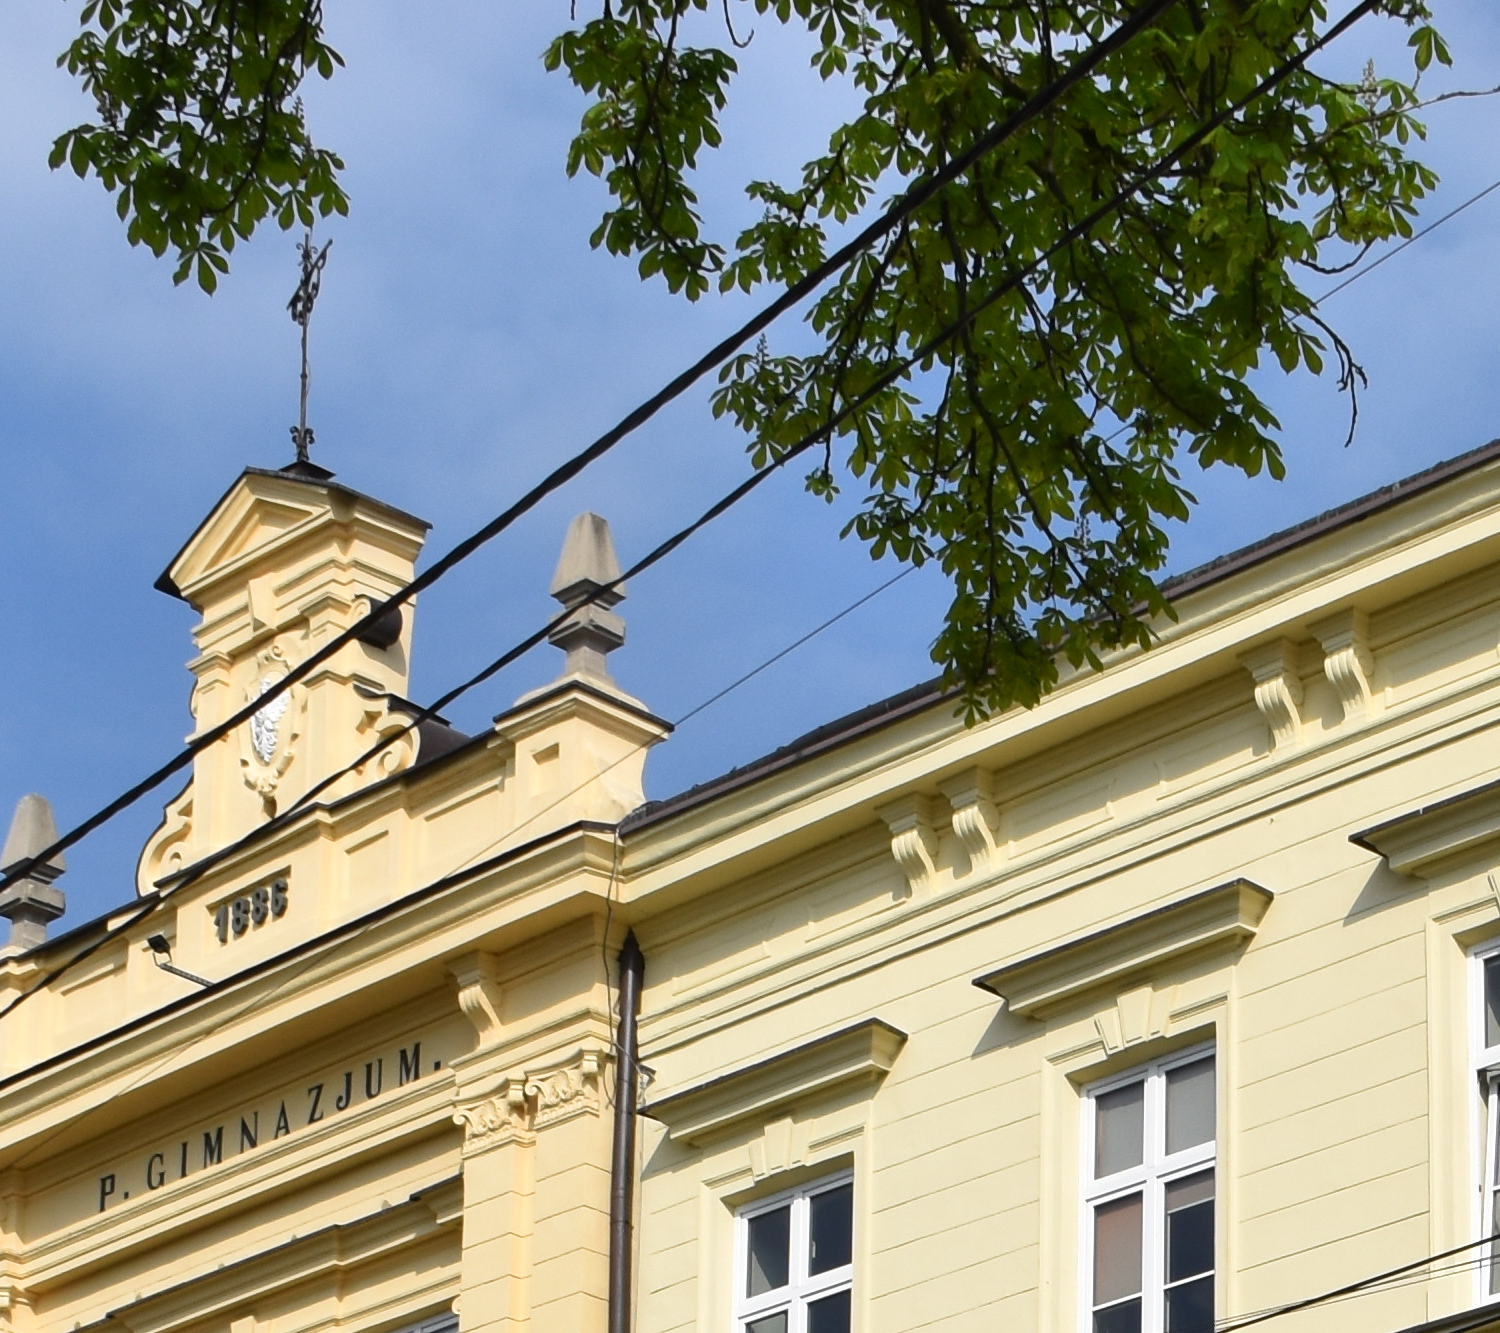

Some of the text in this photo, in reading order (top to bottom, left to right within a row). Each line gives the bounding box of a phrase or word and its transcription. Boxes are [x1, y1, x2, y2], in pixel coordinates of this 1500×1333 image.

[214, 878, 289, 943] 1886
[100, 1042, 442, 1212] P. GIMNAZJUM.
